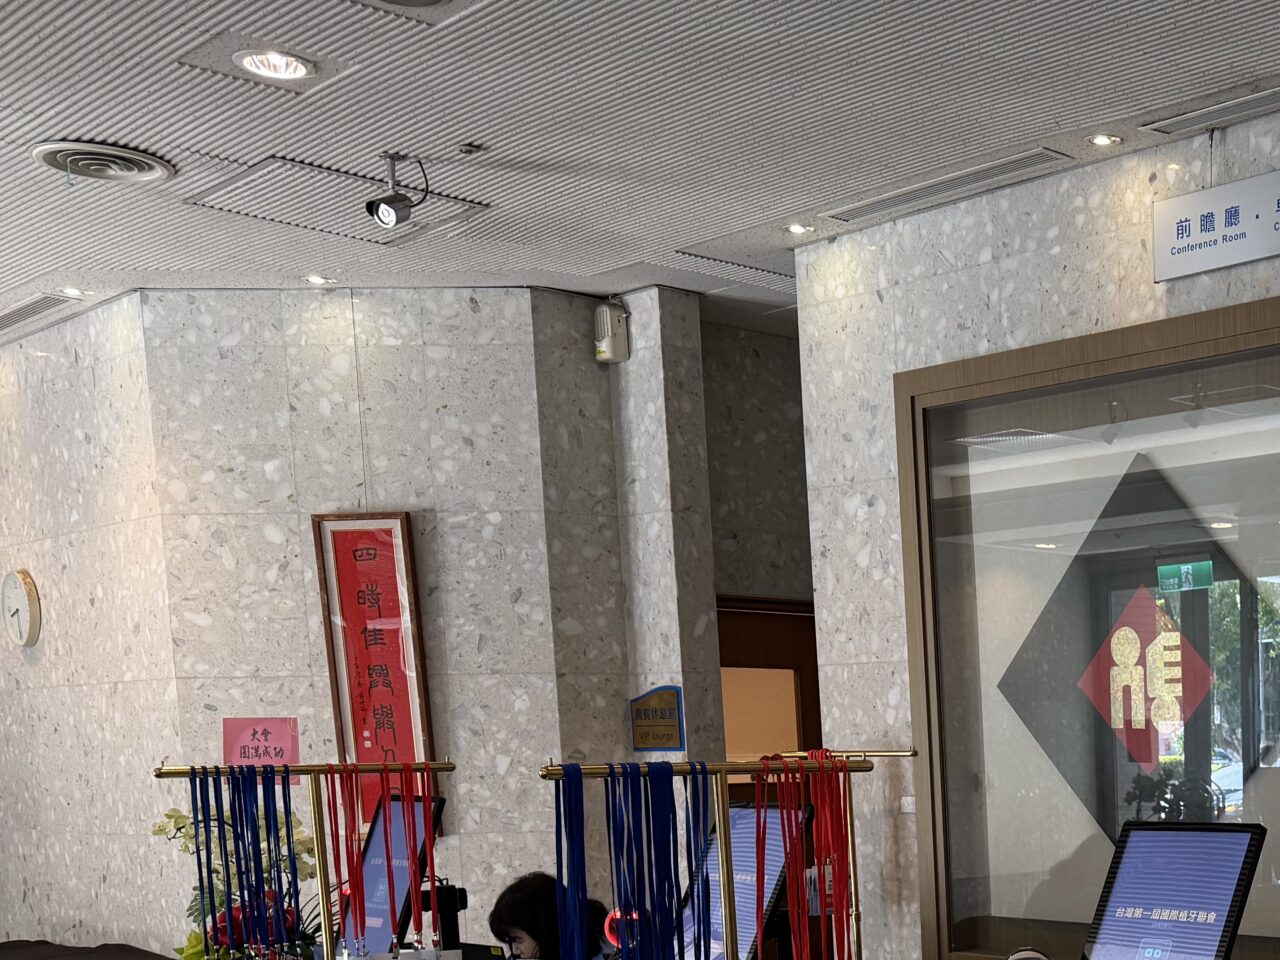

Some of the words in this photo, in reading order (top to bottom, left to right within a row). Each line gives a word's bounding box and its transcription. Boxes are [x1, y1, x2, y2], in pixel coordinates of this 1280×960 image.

[1175, 205, 1241, 240] 前瞻廳
[1170, 239, 1218, 256] Conference
[1222, 231, 1247, 244] Room
[250, 727, 273, 743] 大會
[639, 731, 650, 741] VIP
[1115, 906, 1217, 924] 台灣第一屆國際植牙聯會
